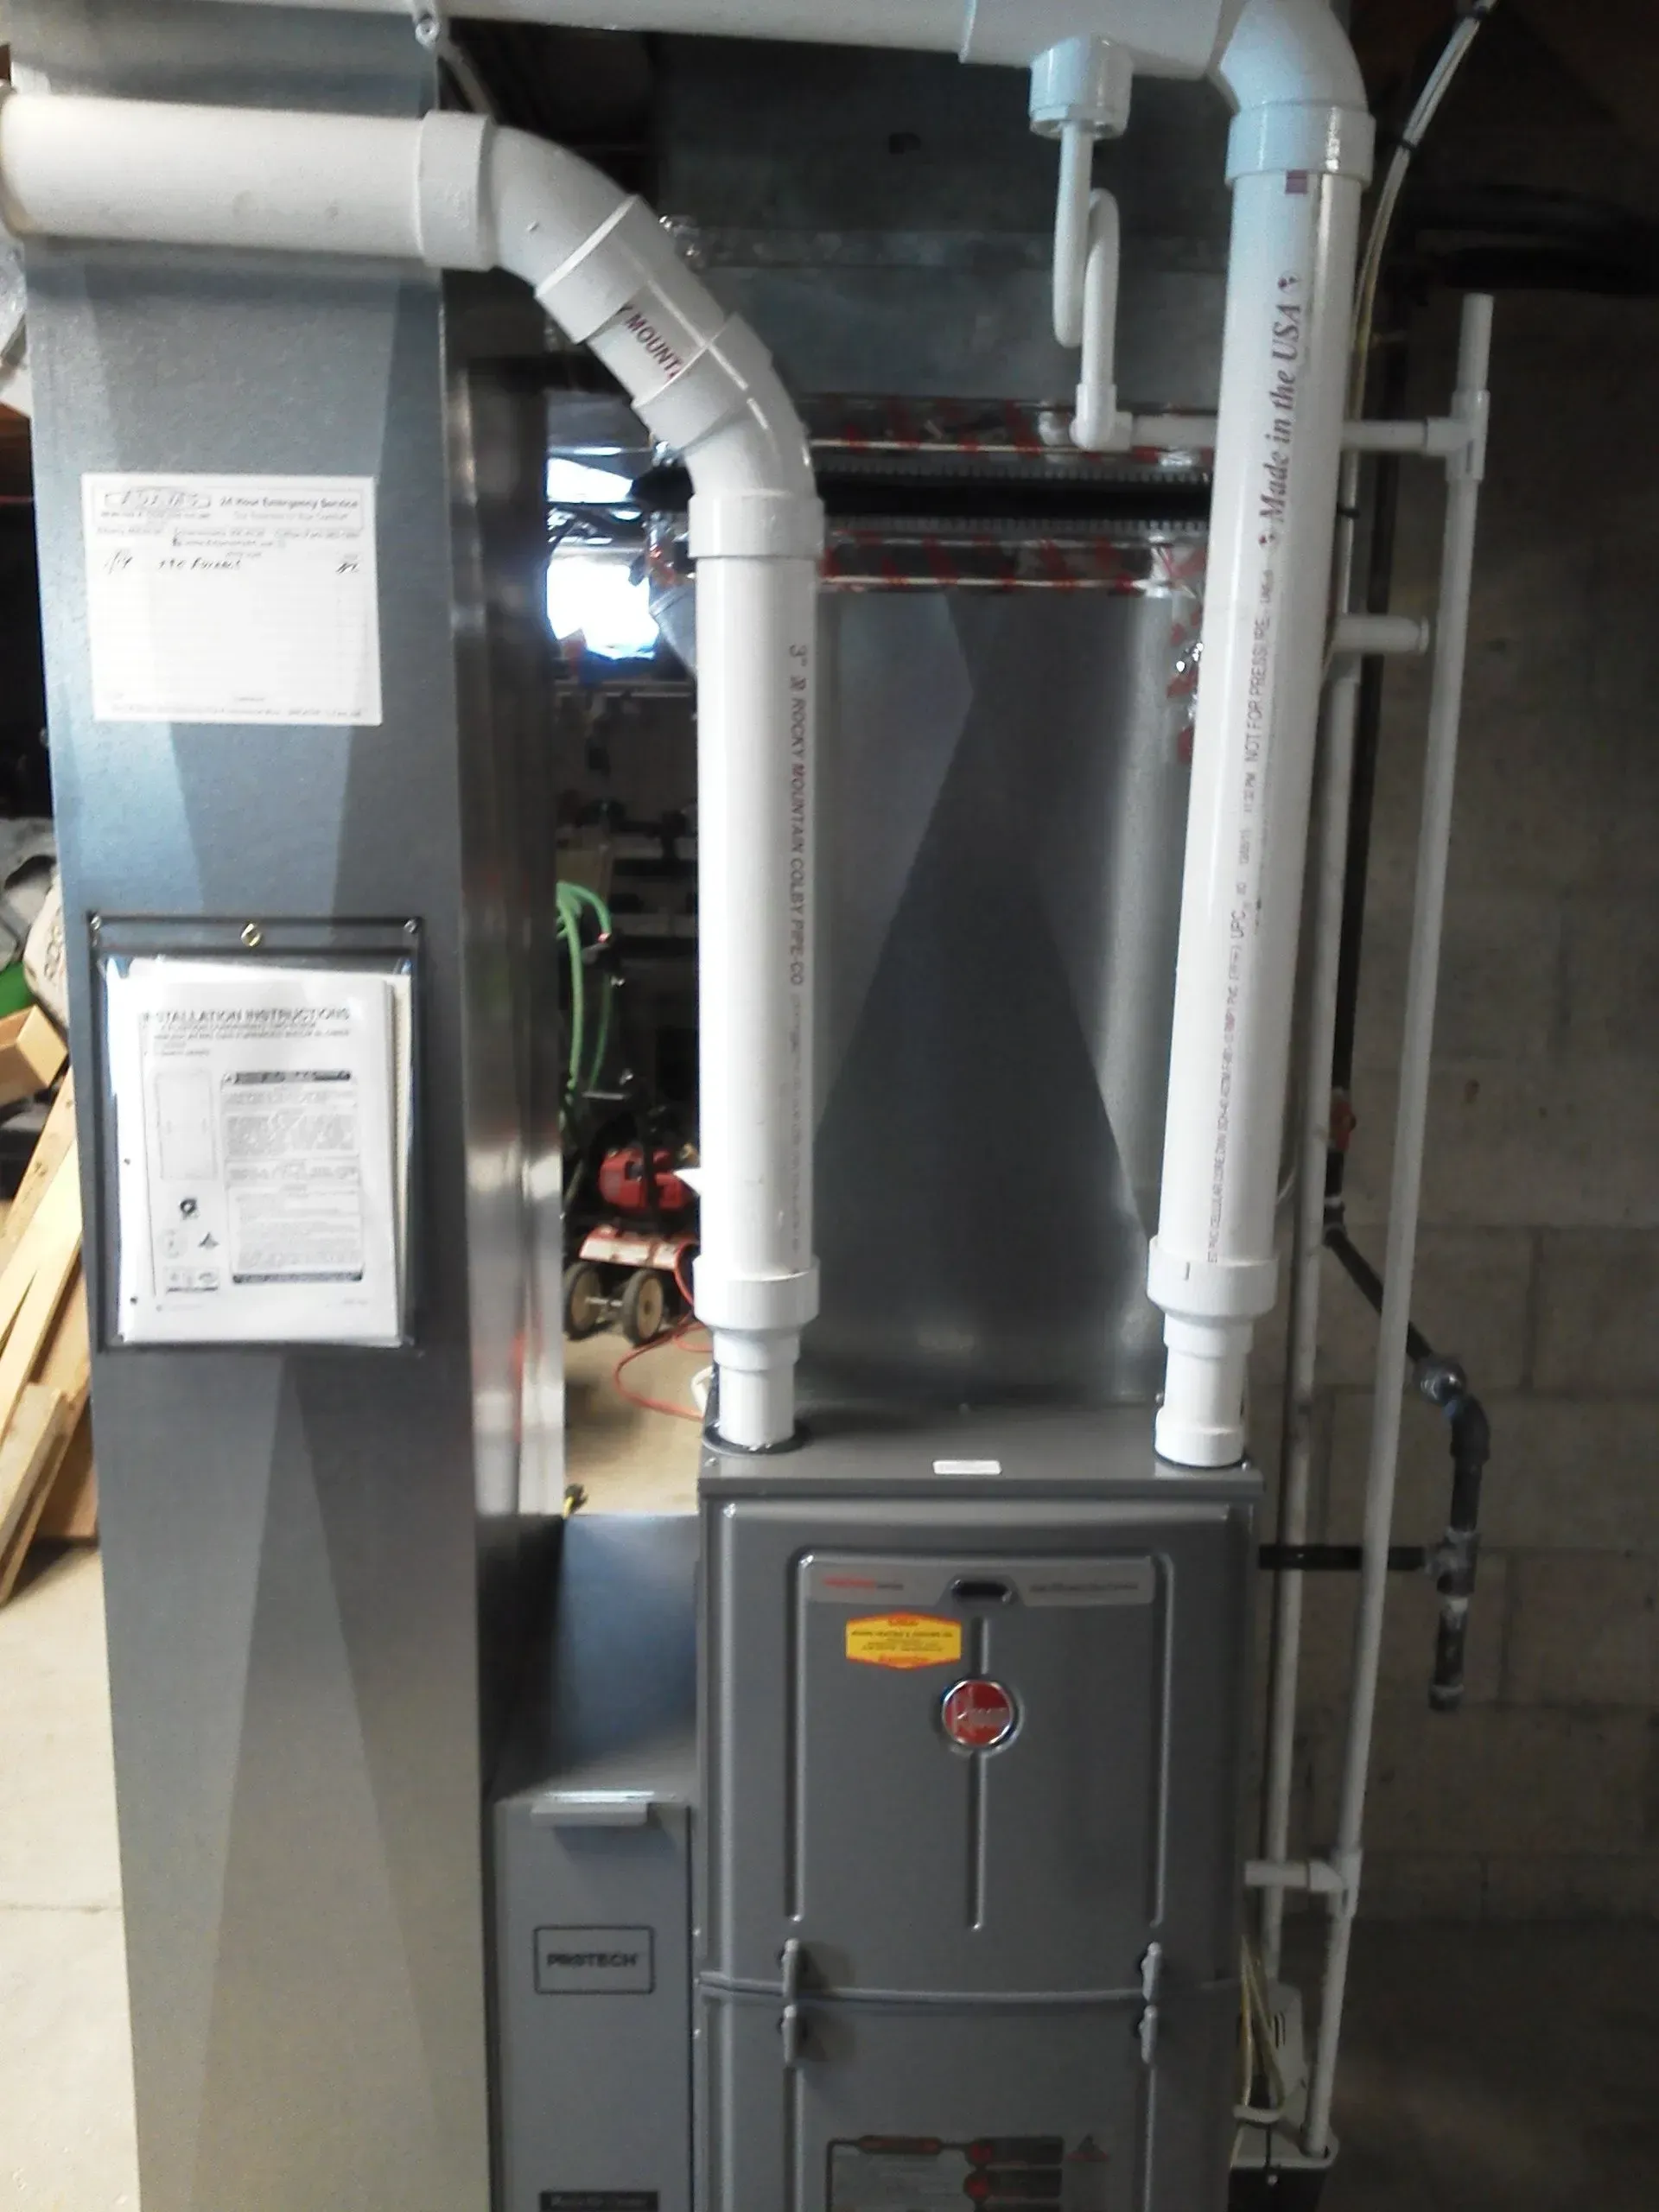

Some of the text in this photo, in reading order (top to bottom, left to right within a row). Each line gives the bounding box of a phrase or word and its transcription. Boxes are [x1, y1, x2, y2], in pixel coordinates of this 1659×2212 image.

[1258, 303, 1301, 522] Made in the USA
[791, 697, 808, 760] ROCKY
[1246, 700, 1263, 729] FOR
[1243, 734, 1262, 762] NOT
[790, 762, 807, 854] MOUNTAIN
[789, 857, 806, 916] COLBY
[1230, 910, 1246, 939] UPC
[245, 1006, 351, 1021] INSTRUCTIONS
[546, 1953, 638, 1967] PROTECH
